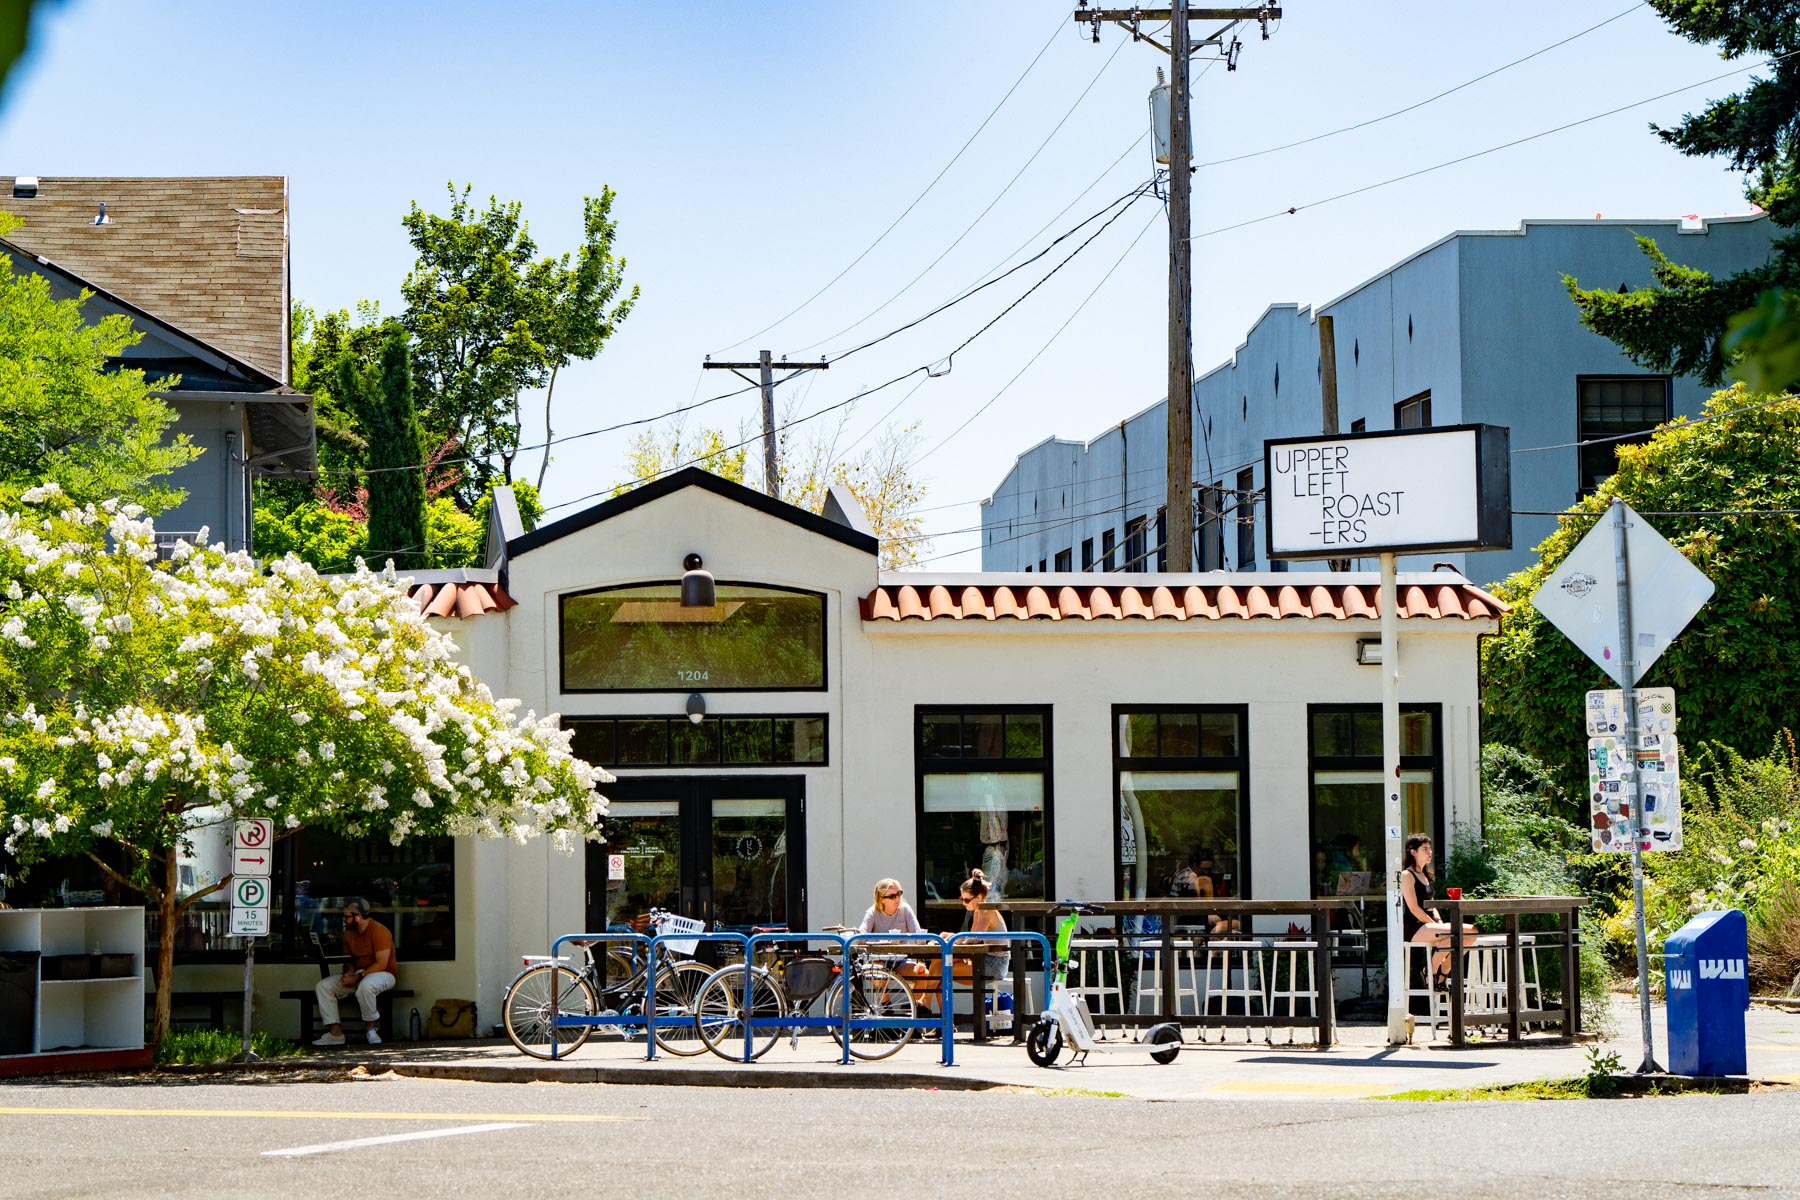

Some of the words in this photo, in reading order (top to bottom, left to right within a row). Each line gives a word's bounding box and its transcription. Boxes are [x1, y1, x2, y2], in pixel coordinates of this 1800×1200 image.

[1275, 446, 1349, 474] UPPER
[1293, 471, 1349, 497] LEFT
[1322, 491, 1405, 519] ROAST
[677, 670, 709, 681] 1204
[245, 885, 258, 901] P
[245, 910, 257, 920] 15
